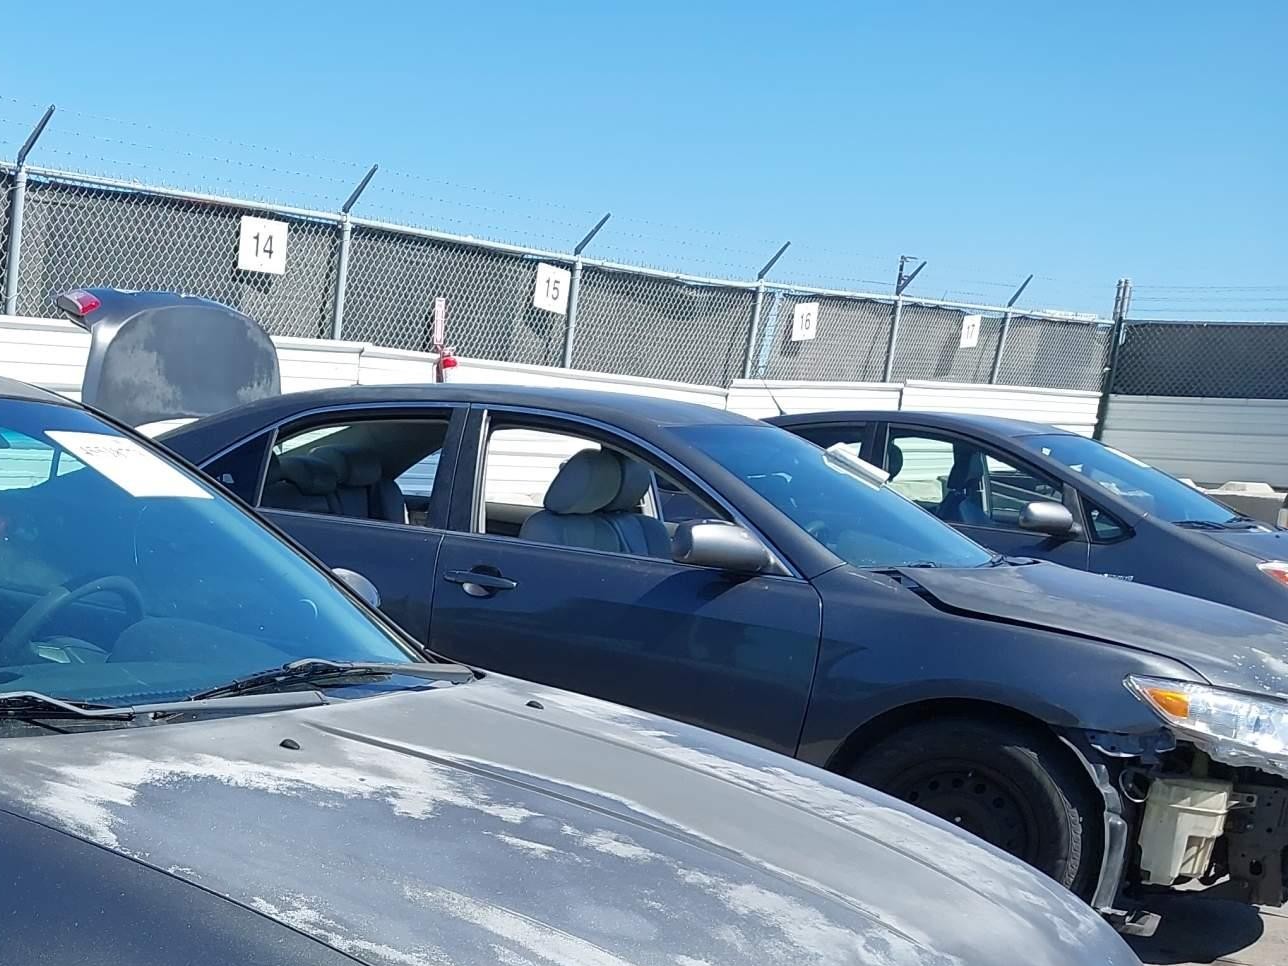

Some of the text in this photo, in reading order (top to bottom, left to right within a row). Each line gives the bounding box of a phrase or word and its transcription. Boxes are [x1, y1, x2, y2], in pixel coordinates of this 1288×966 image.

[253, 231, 274, 259] 14
[545, 276, 561, 301] 15
[800, 312, 812, 330] 16
